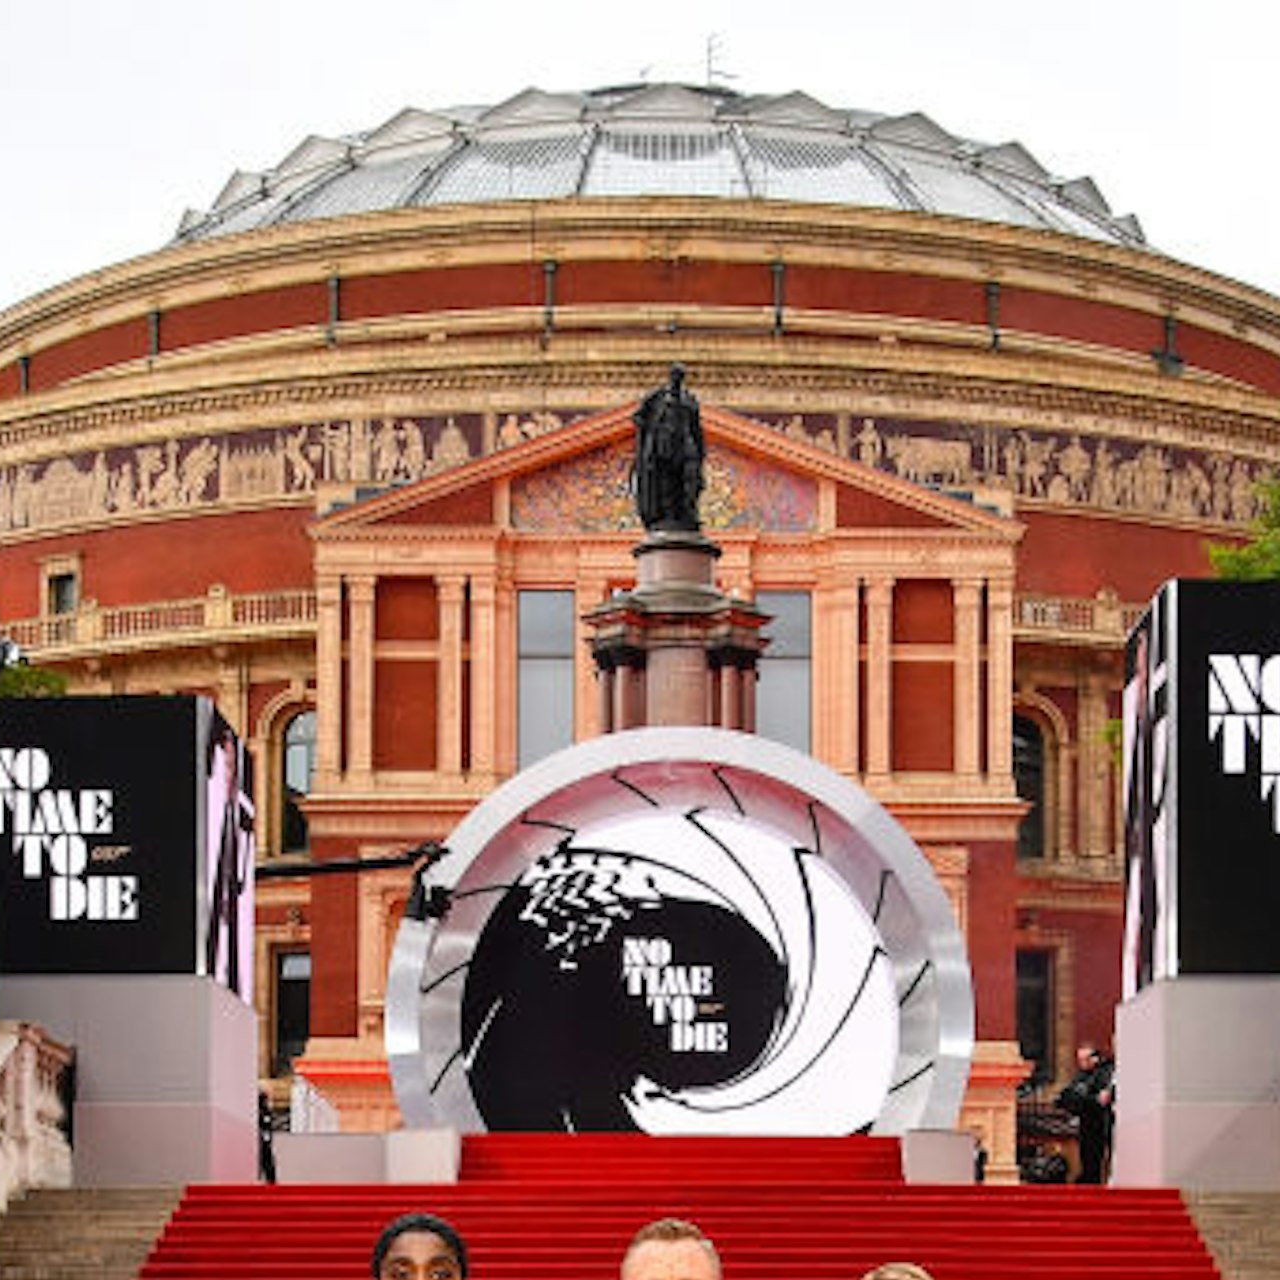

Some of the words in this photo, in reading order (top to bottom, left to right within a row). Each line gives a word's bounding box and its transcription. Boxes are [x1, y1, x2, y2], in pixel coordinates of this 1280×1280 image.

[12, 833, 87, 878] TO
[49, 875, 139, 921] DIE
[623, 936, 672, 967] NO
[623, 965, 714, 996] TIME
[646, 995, 696, 1026] TO
[671, 1021, 729, 1052] DIE
